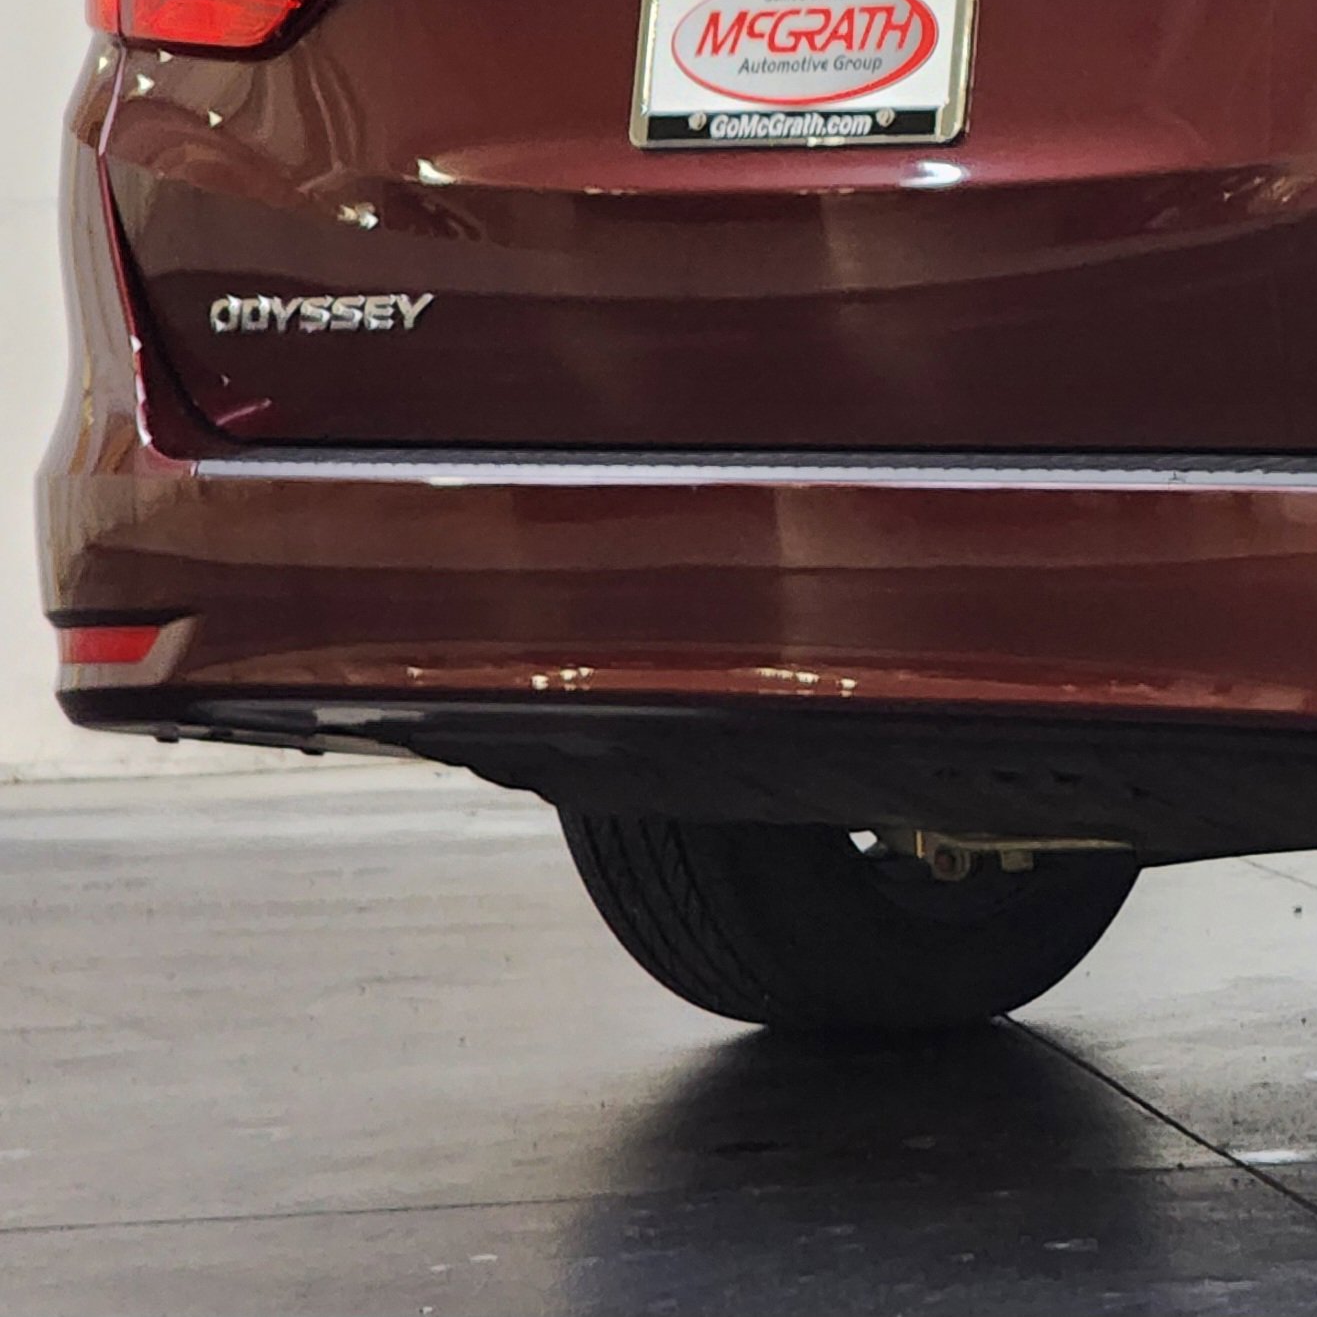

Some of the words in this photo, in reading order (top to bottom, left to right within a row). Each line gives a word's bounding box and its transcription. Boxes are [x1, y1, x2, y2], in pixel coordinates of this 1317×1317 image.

[737, 56, 829, 75] Automotive
[833, 54, 883, 73] Group
[709, 112, 873, 139] GoMcGrath.com
[209, 292, 435, 333] ODYSSEY
